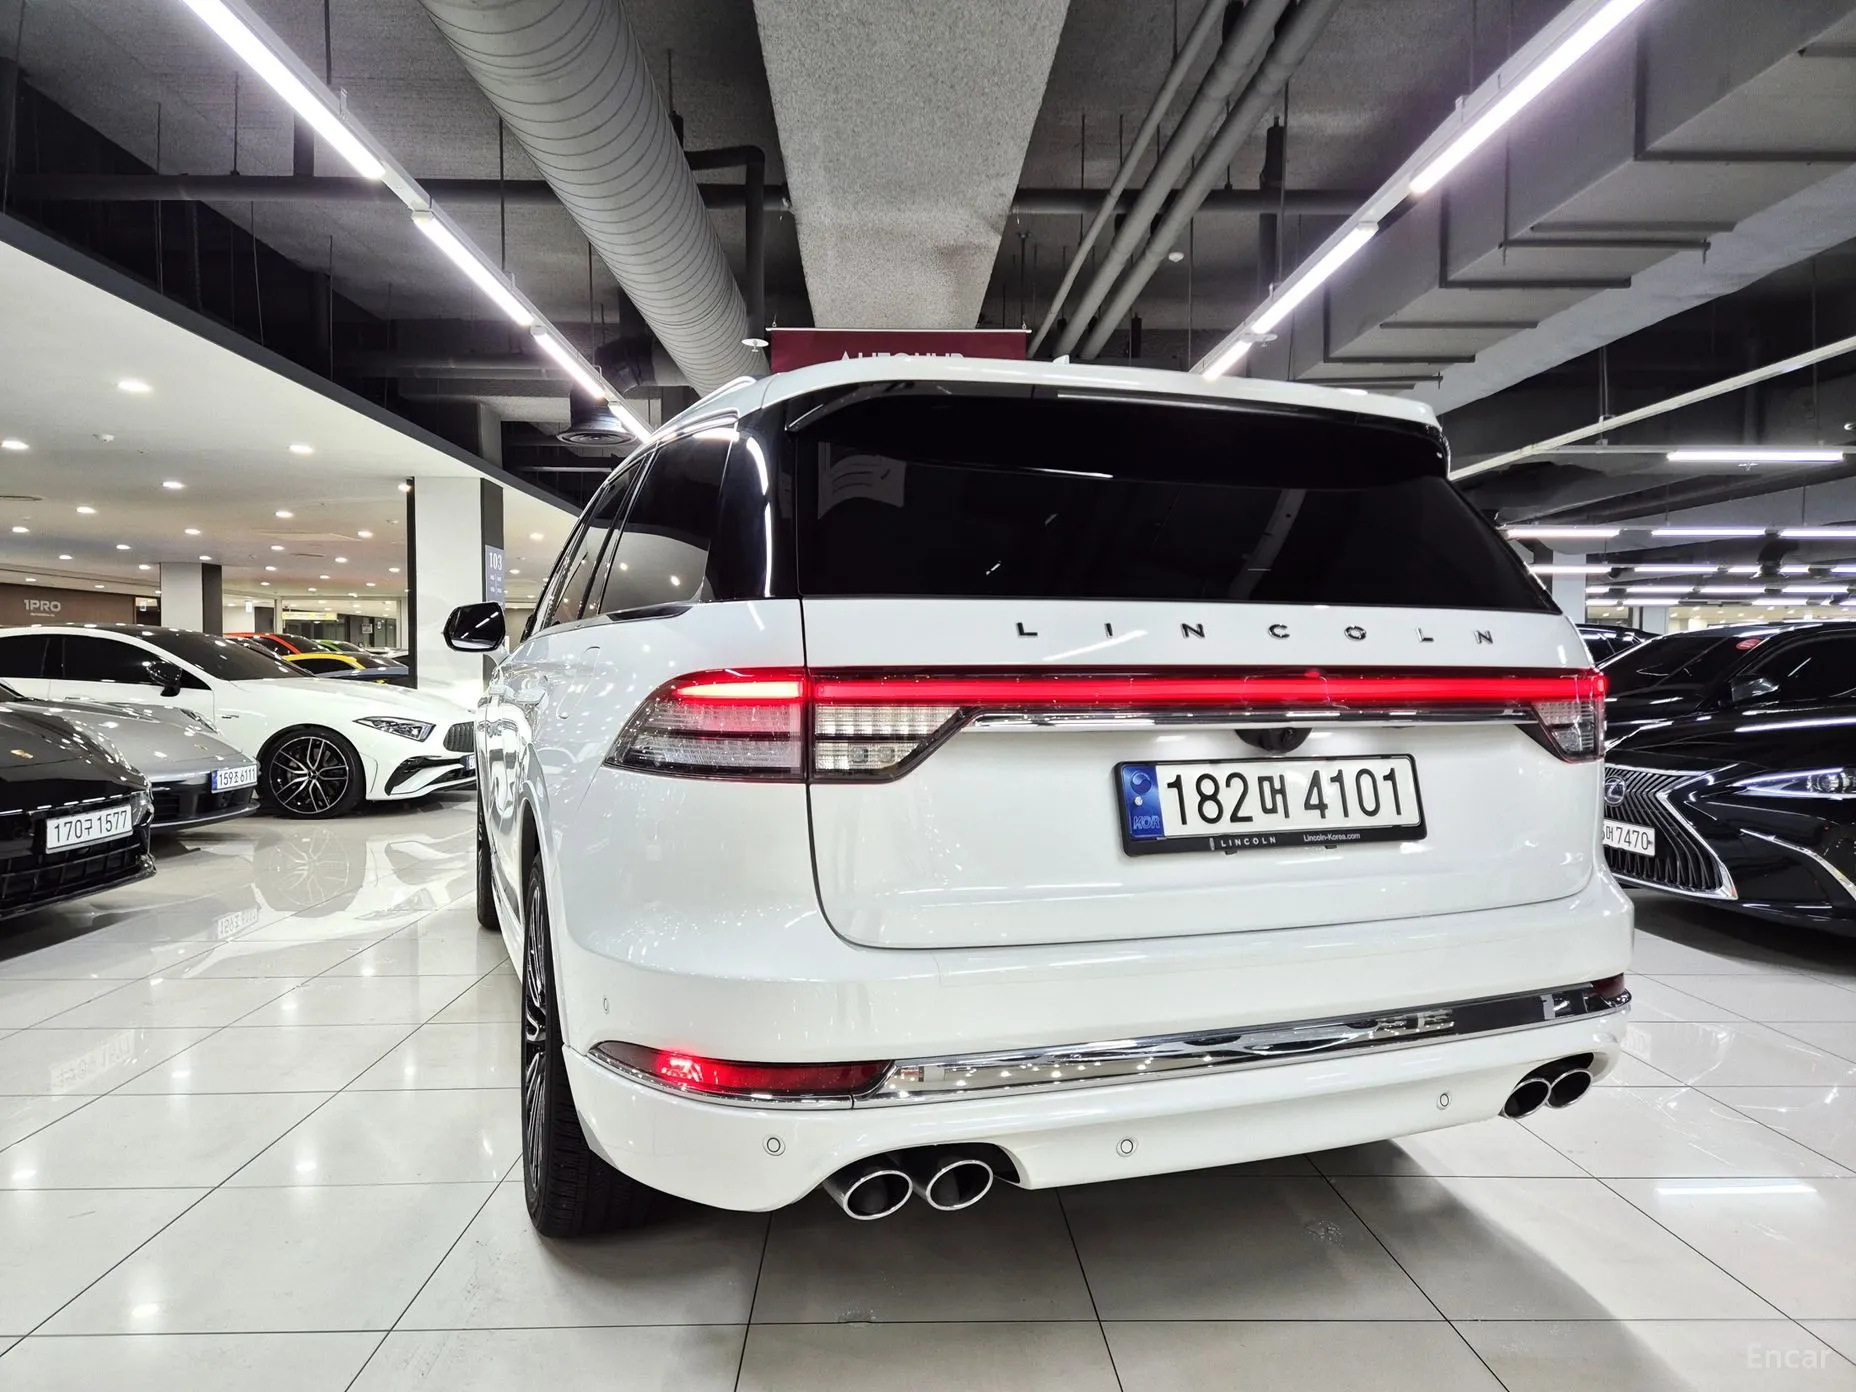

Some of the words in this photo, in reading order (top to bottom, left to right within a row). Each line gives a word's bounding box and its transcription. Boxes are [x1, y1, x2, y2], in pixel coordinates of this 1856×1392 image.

[489, 552, 502, 571] 103
[1016, 621, 1494, 645] LINCOLN
[1167, 771, 1289, 825] 182머
[1304, 767, 1401, 819] 4101
[54, 818, 93, 843] 170구
[97, 810, 127, 834] 1577
[1133, 815, 1160, 829] KOR
[1220, 837, 1276, 847] LINCOLN
[1303, 833, 1360, 842] Lincoln-Korea.com
[1616, 826, 1648, 850] 7470
